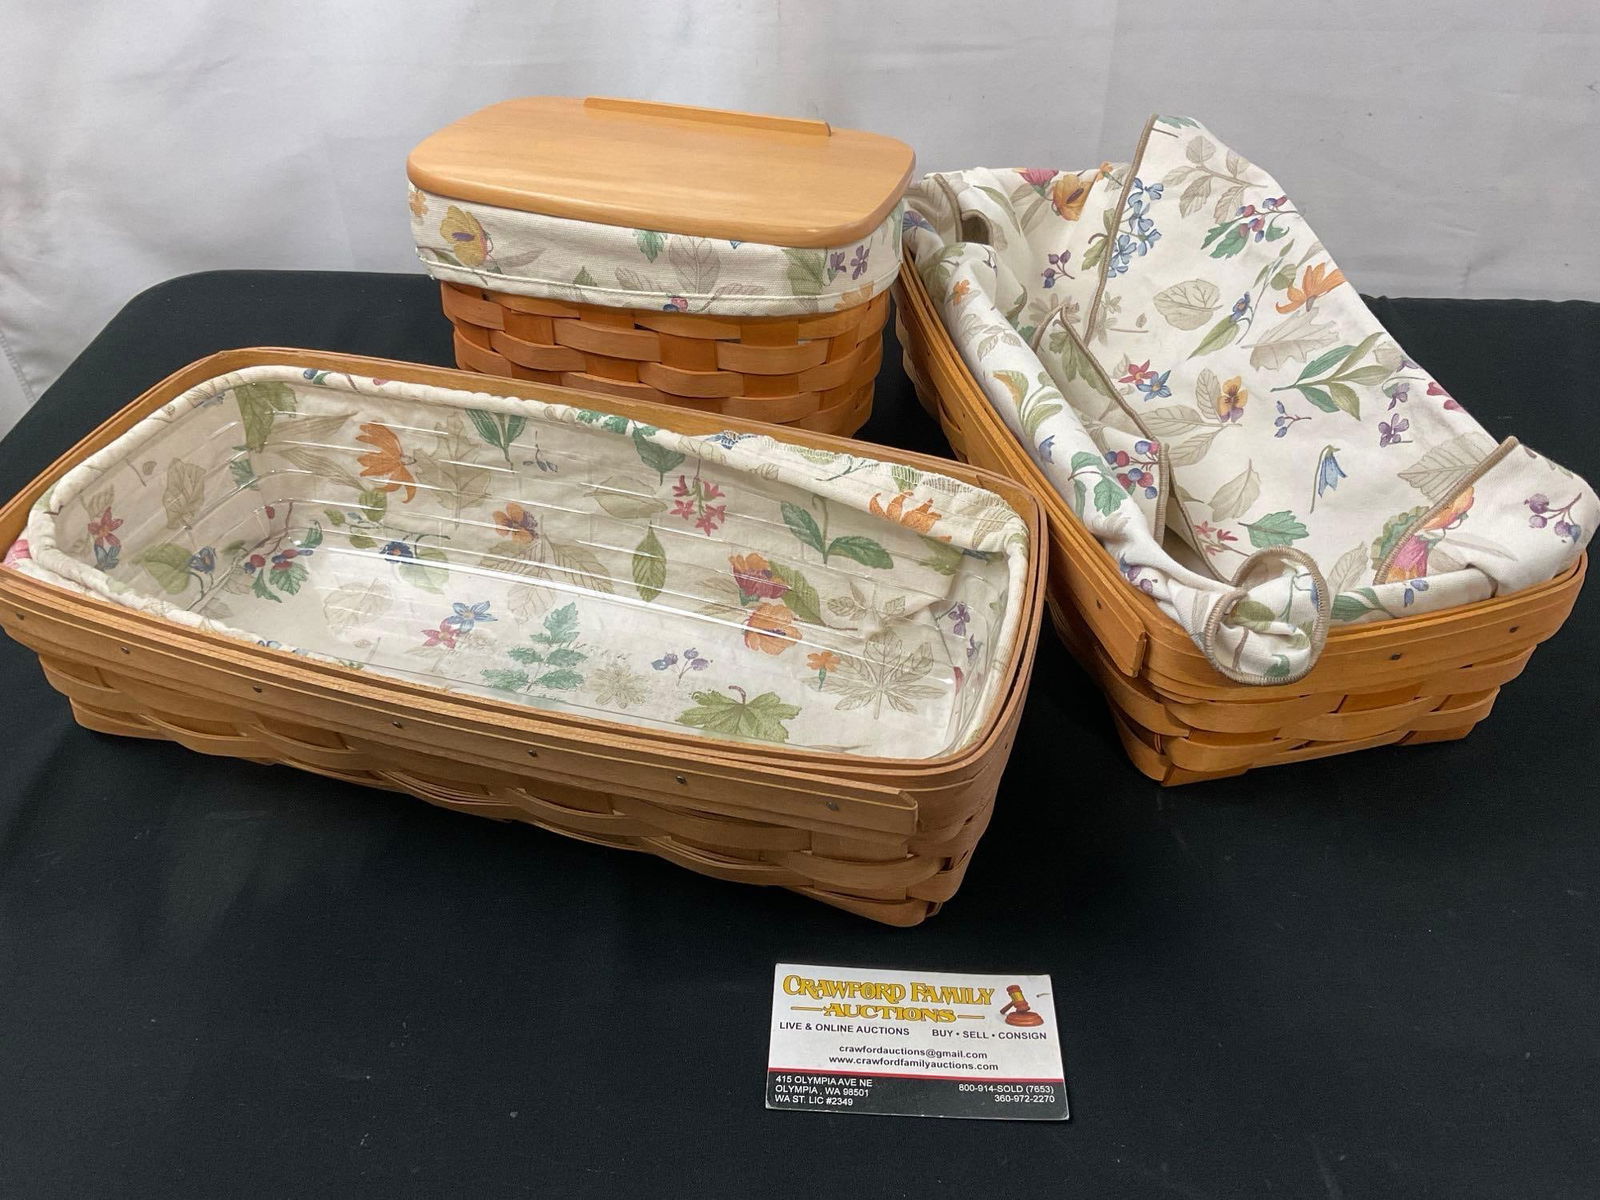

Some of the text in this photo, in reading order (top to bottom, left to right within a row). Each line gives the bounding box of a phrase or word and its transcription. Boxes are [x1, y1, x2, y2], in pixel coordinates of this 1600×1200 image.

[783, 974, 995, 1005] CRAWFORD FAMILY
[823, 1003, 957, 1023] AUCTIONS
[780, 1022, 910, 1035] LIVE & ONLINE AUCTIONS
[932, 1029, 1047, 1040] BUY SELL CONSIGN
[839, 1045, 988, 1059] crawfordauctions@gmail.com
[829, 1056, 998, 1071] www.crawfordfamilyauctions.com
[794, 1076, 836, 1085] OLYMPIA
[838, 1078, 857, 1086] AVE
[775, 1085, 817, 1094] OLYMPIA
[825, 1087, 841, 1095] WA
[843, 1088, 869, 1096] 98501
[959, 1084, 1054, 1094] 800-914-SOLD (7653)
[775, 1095, 790, 1103] WA
[825, 1097, 853, 1105] #2349
[995, 1094, 1055, 1103] 360-972-2270
